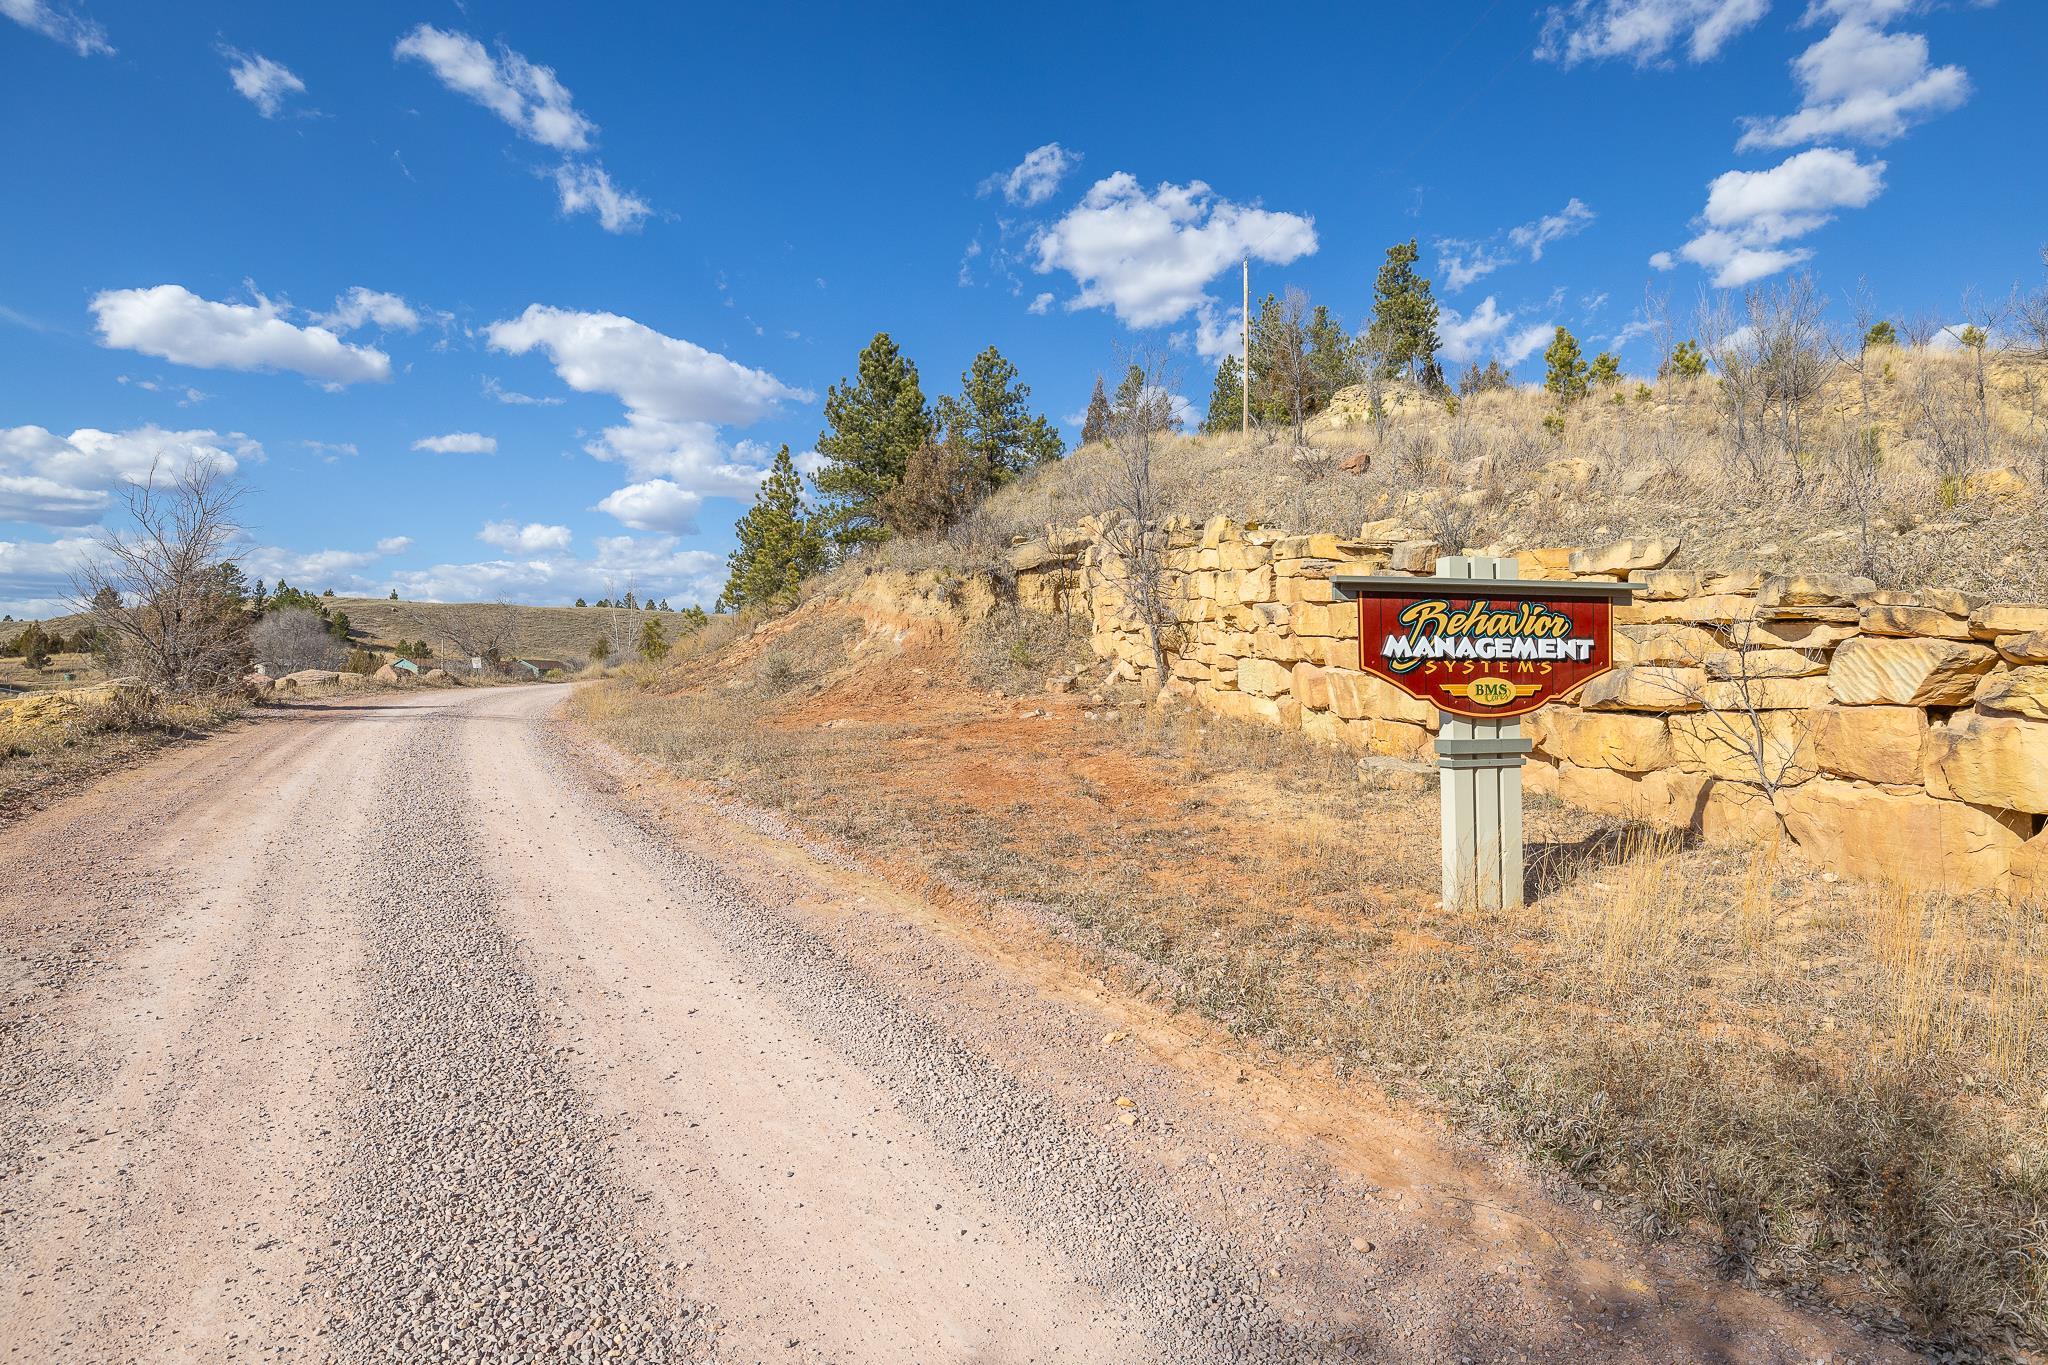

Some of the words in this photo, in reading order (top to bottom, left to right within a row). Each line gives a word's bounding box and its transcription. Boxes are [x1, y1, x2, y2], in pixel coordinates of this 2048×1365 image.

[1400, 599, 1571, 645] Behavior
[1382, 634, 1594, 660] MANAGEMENT
[1424, 660, 1552, 674] SYSTEMS
[1475, 684, 1508, 696] BMS
